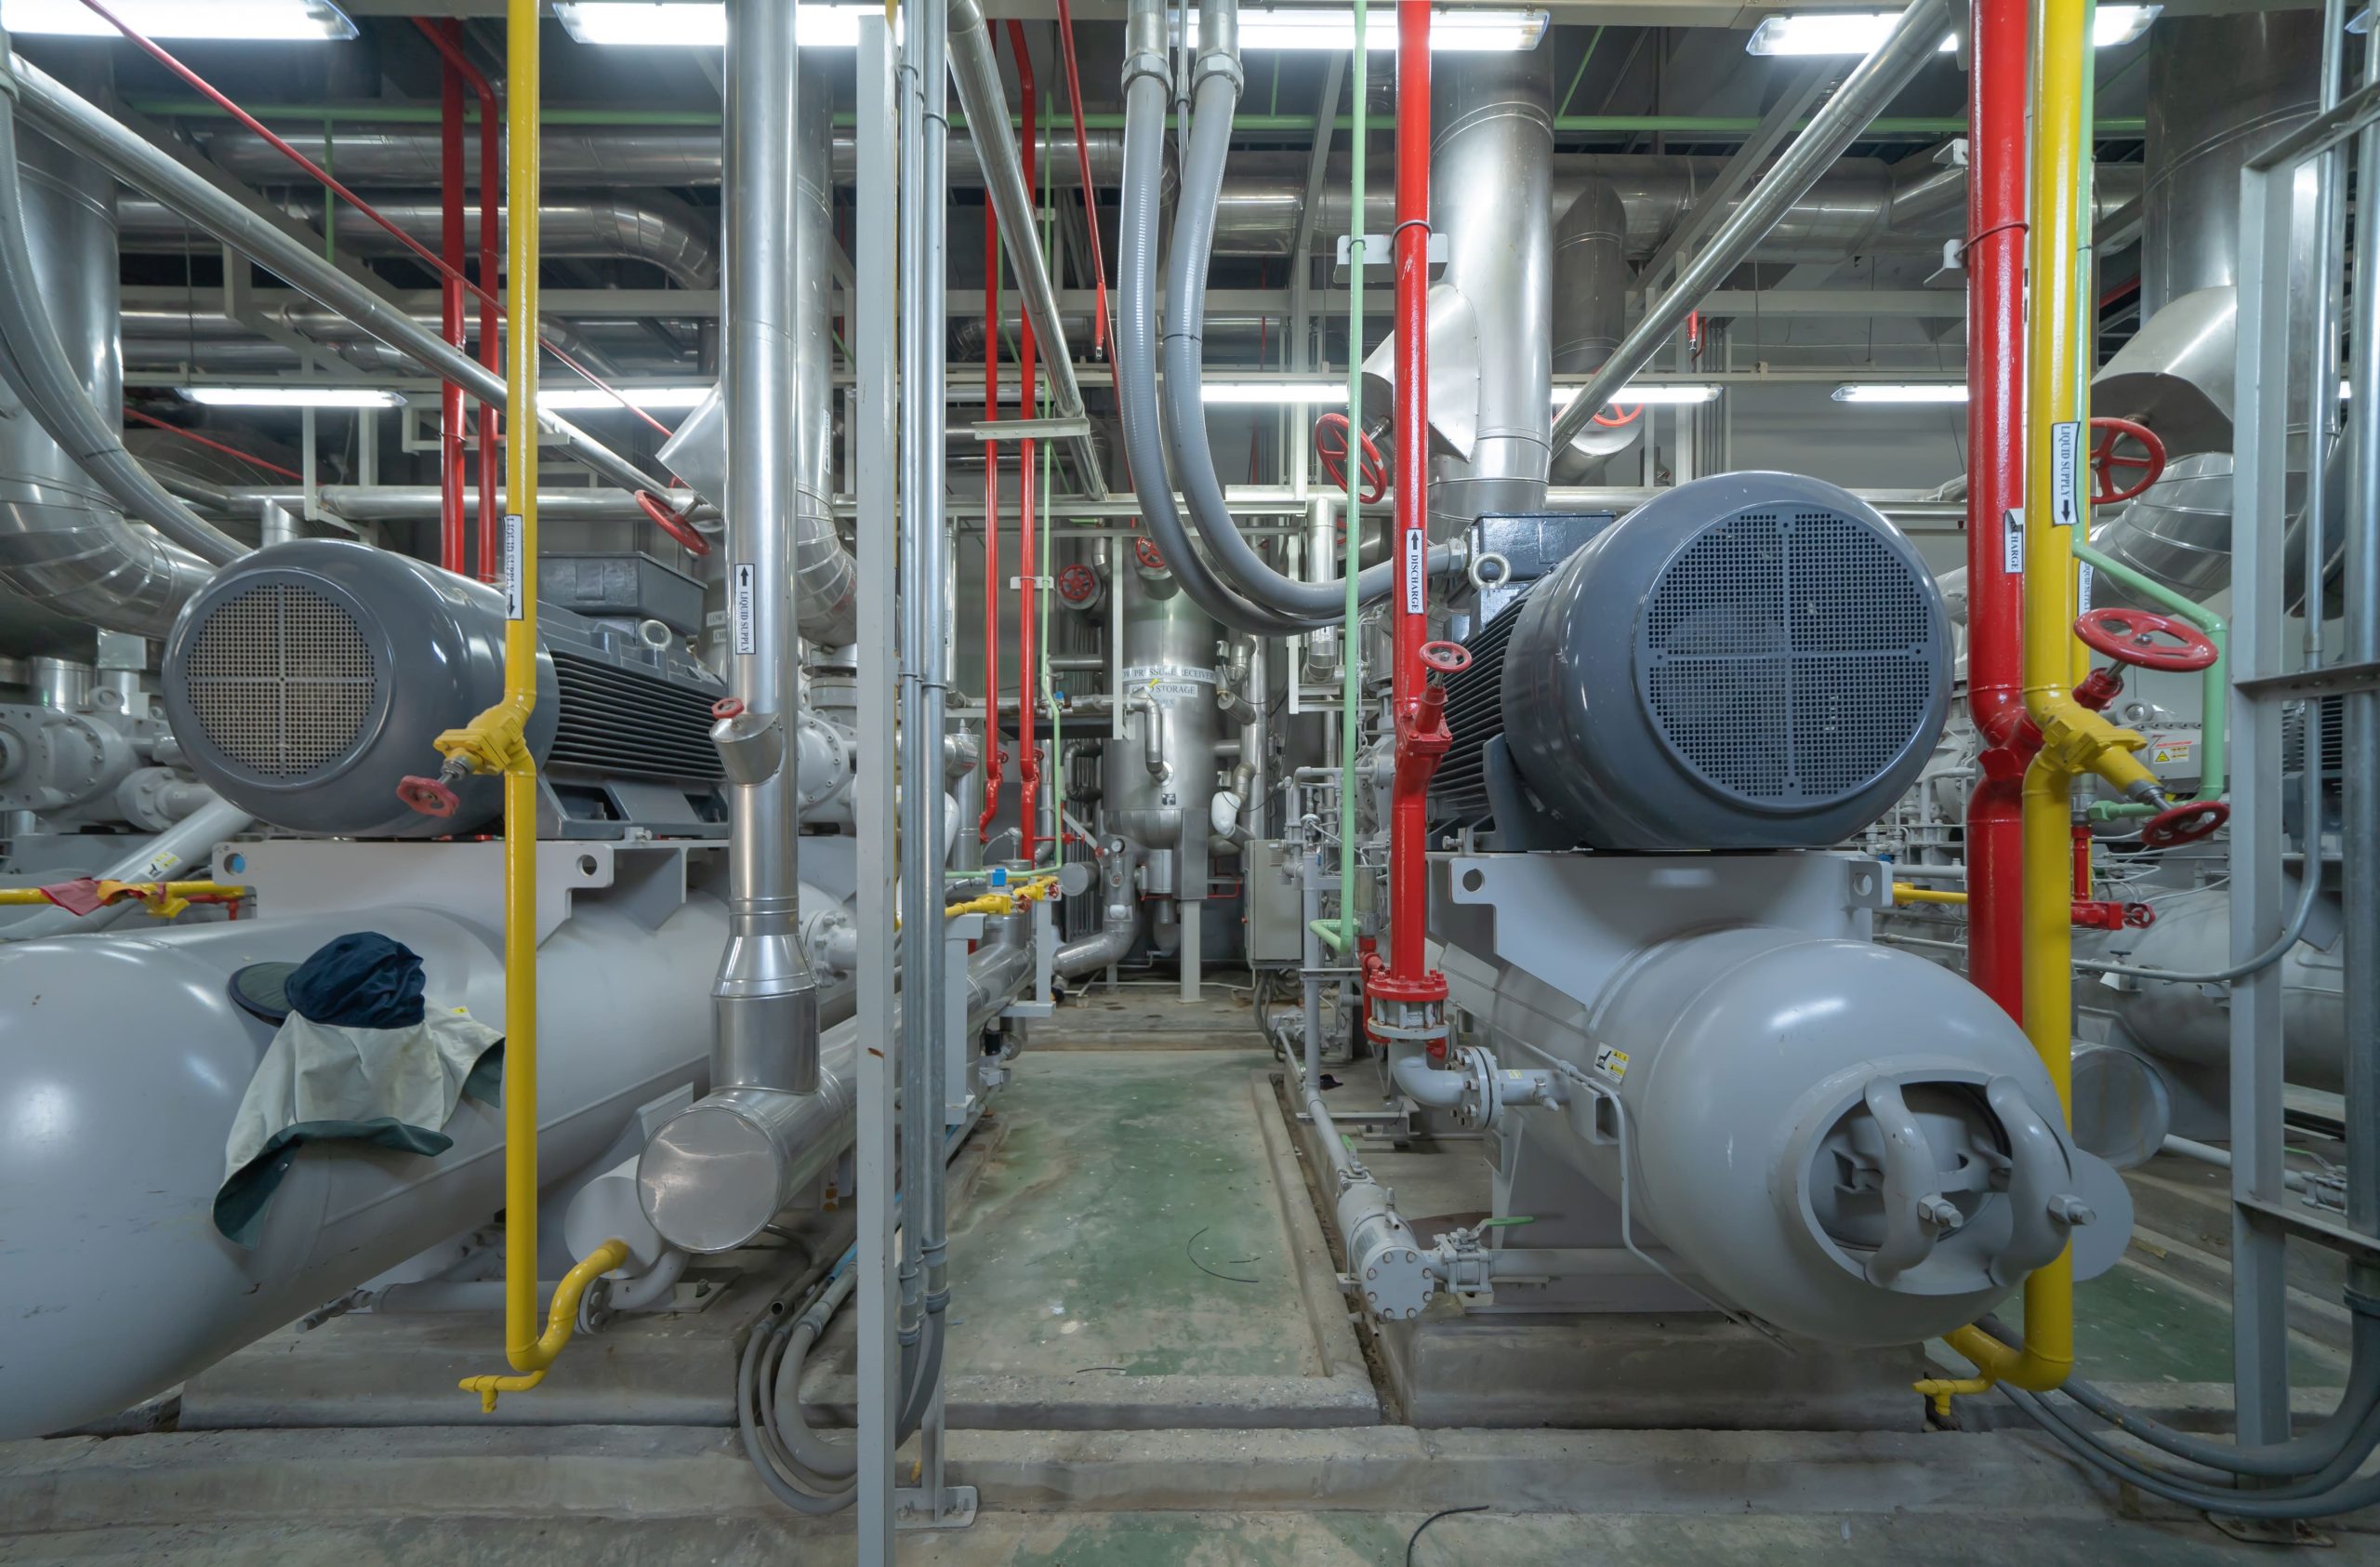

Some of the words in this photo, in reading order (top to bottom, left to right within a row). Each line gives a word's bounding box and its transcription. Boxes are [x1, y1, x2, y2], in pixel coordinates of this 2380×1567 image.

[2058, 425, 2070, 458] LIQUID
[2060, 460, 2070, 497] SUPPLY
[506, 517, 515, 551] LIQUID
[1410, 554, 1419, 611] DISCHARGE
[739, 591, 749, 620] LIQUID
[740, 621, 749, 652] SUPPLY
[1134, 668, 1176, 678] PRSSUE
[1156, 684, 1196, 695] STORAGE
